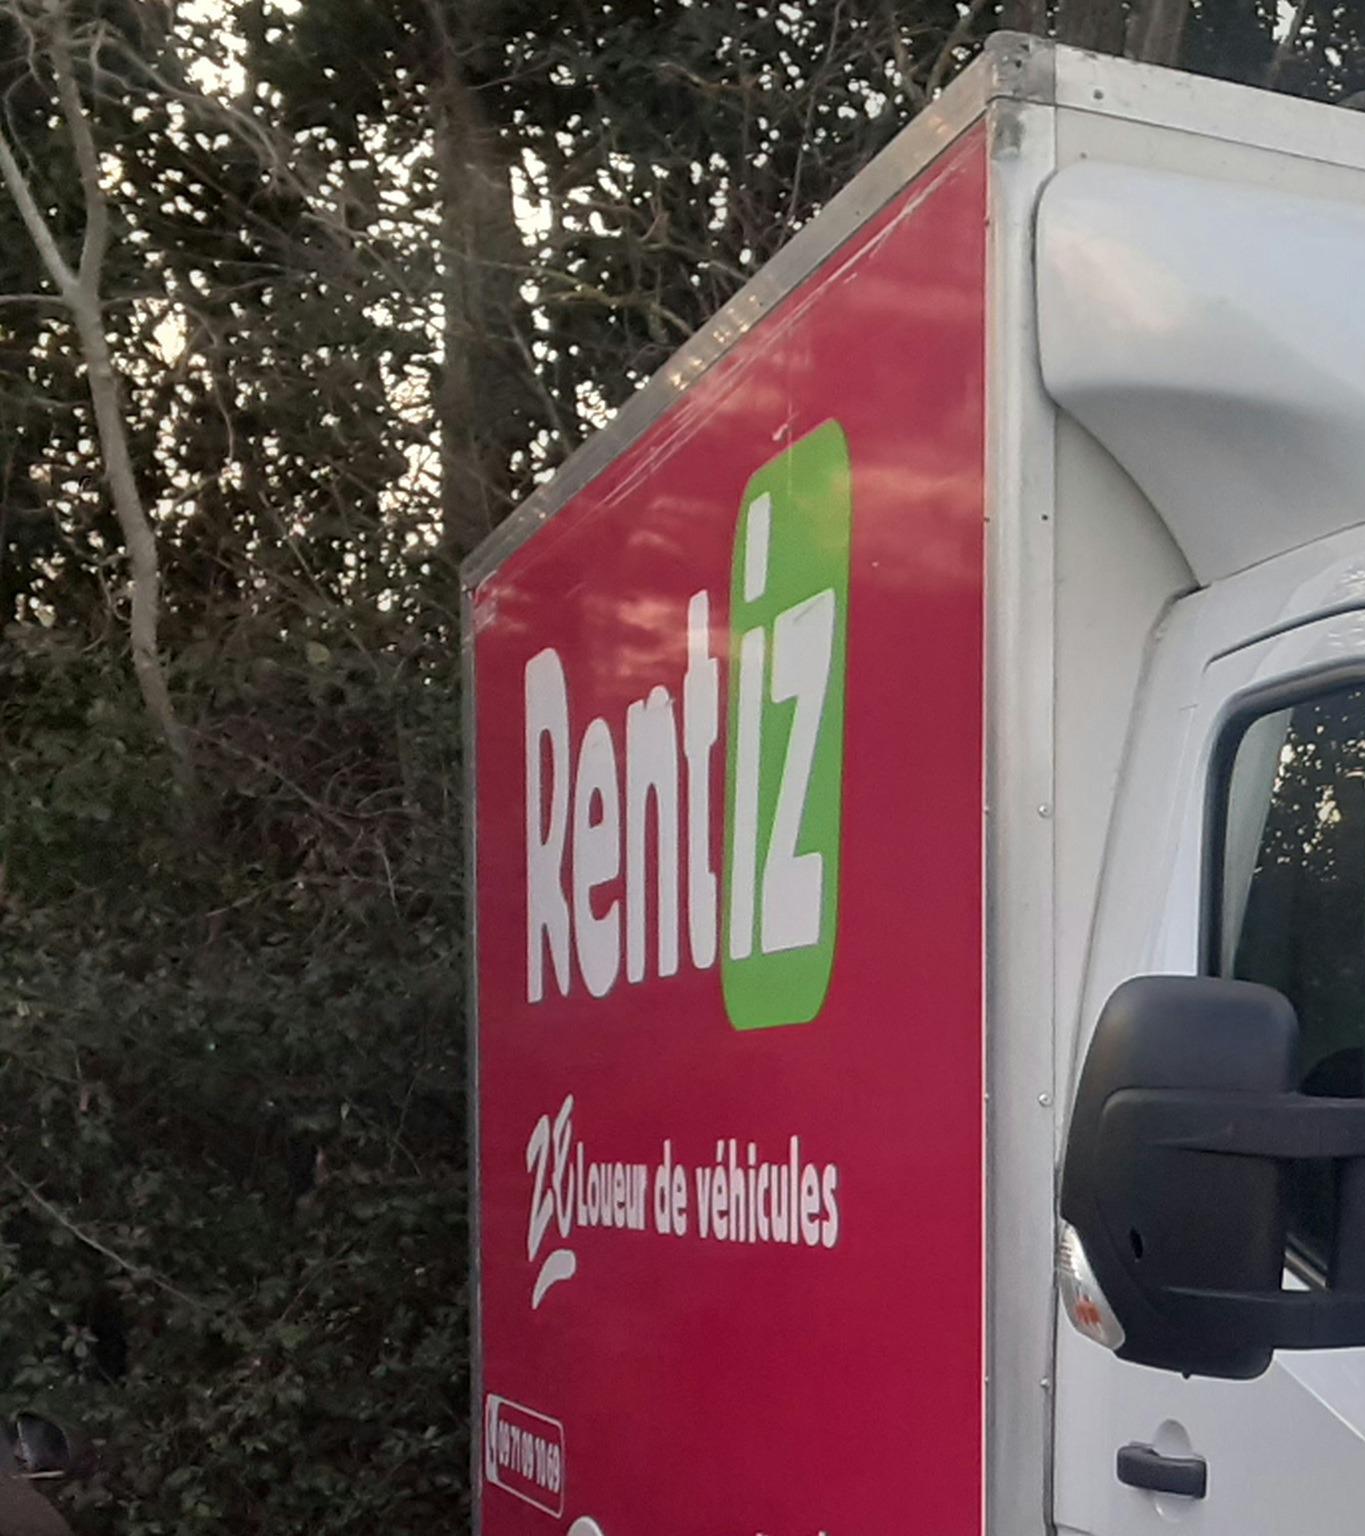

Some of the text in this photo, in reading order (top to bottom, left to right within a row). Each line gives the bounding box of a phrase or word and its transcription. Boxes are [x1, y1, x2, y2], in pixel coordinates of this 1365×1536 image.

[525, 490, 836, 1003] Rentiz
[576, 1141, 648, 1230] Loueur
[654, 1139, 688, 1237] de
[696, 1135, 839, 1249] véhicules
